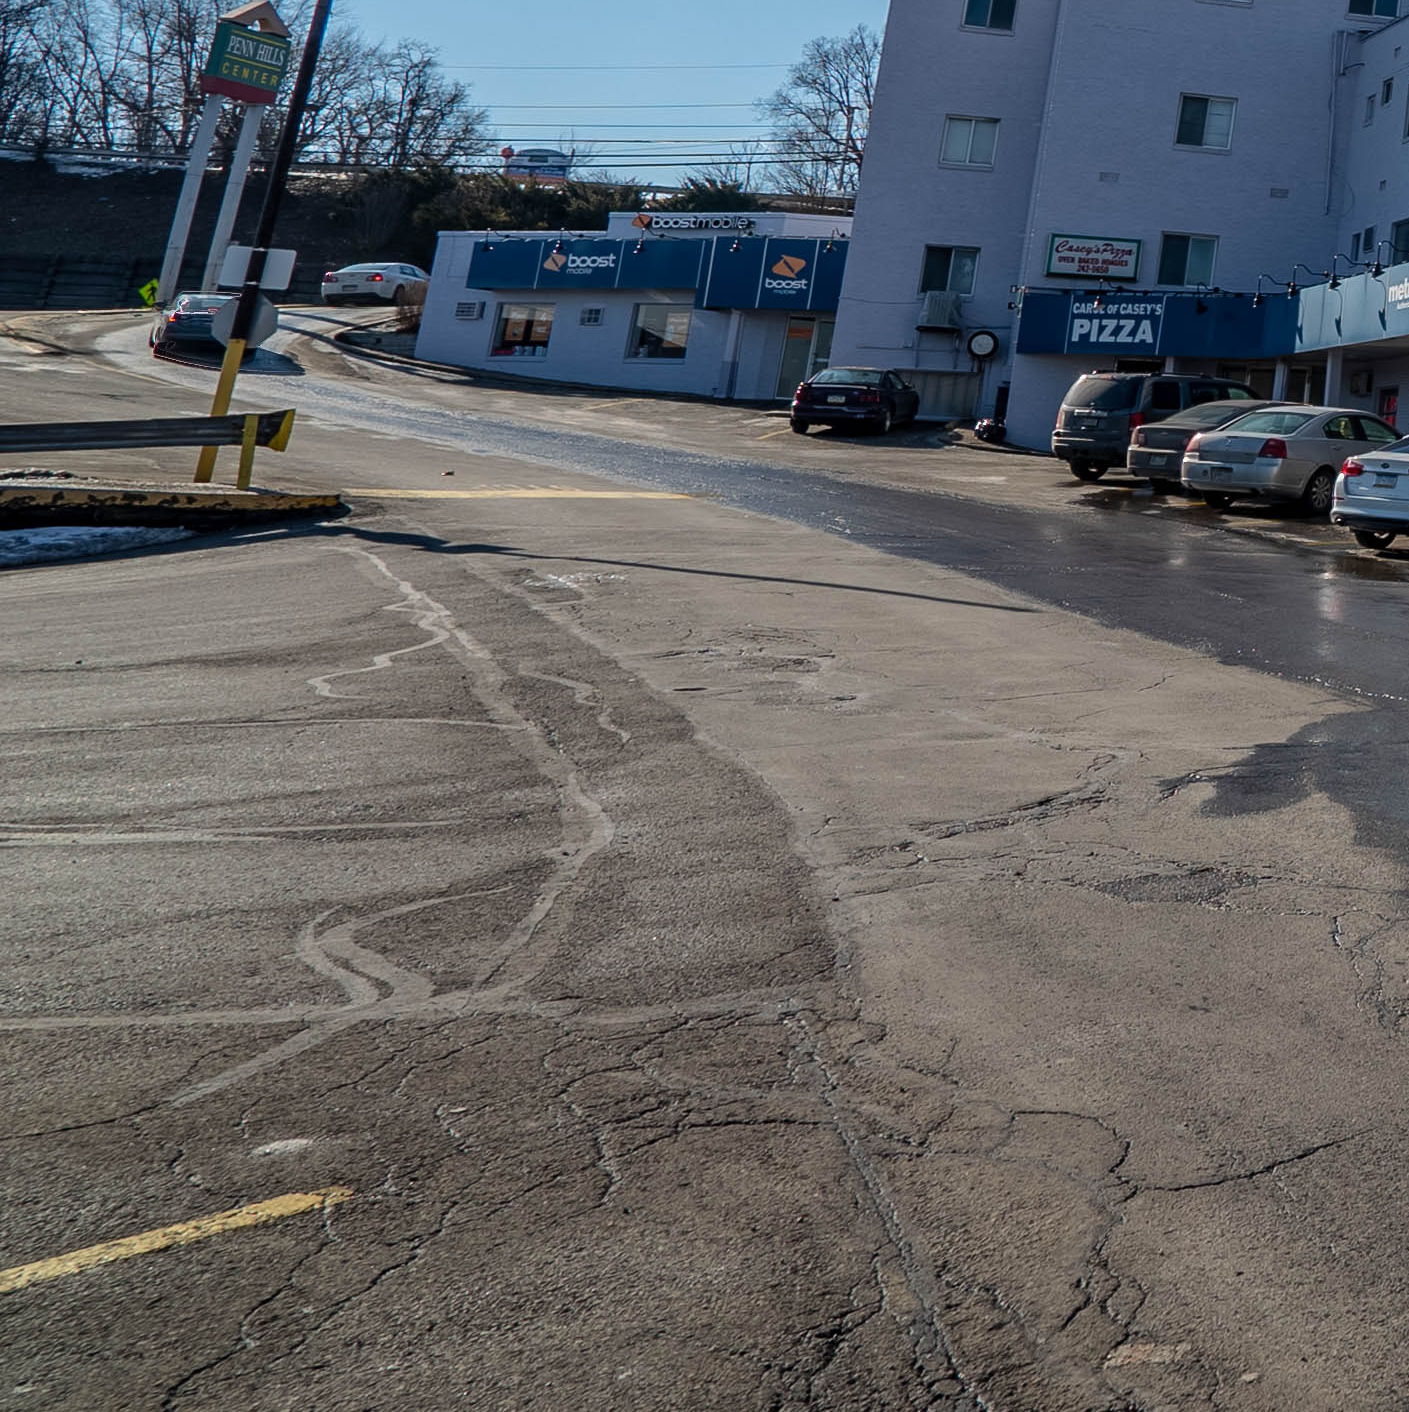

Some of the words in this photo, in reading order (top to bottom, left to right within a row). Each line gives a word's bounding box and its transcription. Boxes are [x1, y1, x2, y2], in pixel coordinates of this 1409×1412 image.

[226, 35, 257, 57] PENN
[256, 43, 286, 66] HILLS
[222, 62, 278, 86] CENTER
[567, 253, 616, 267] boost
[1055, 240, 1101, 256] Casey's
[1100, 243, 1134, 260] Pizza
[765, 277, 808, 289] boost
[1119, 303, 1163, 315] CASEY'S
[1071, 318, 1154, 343] PIZZA
